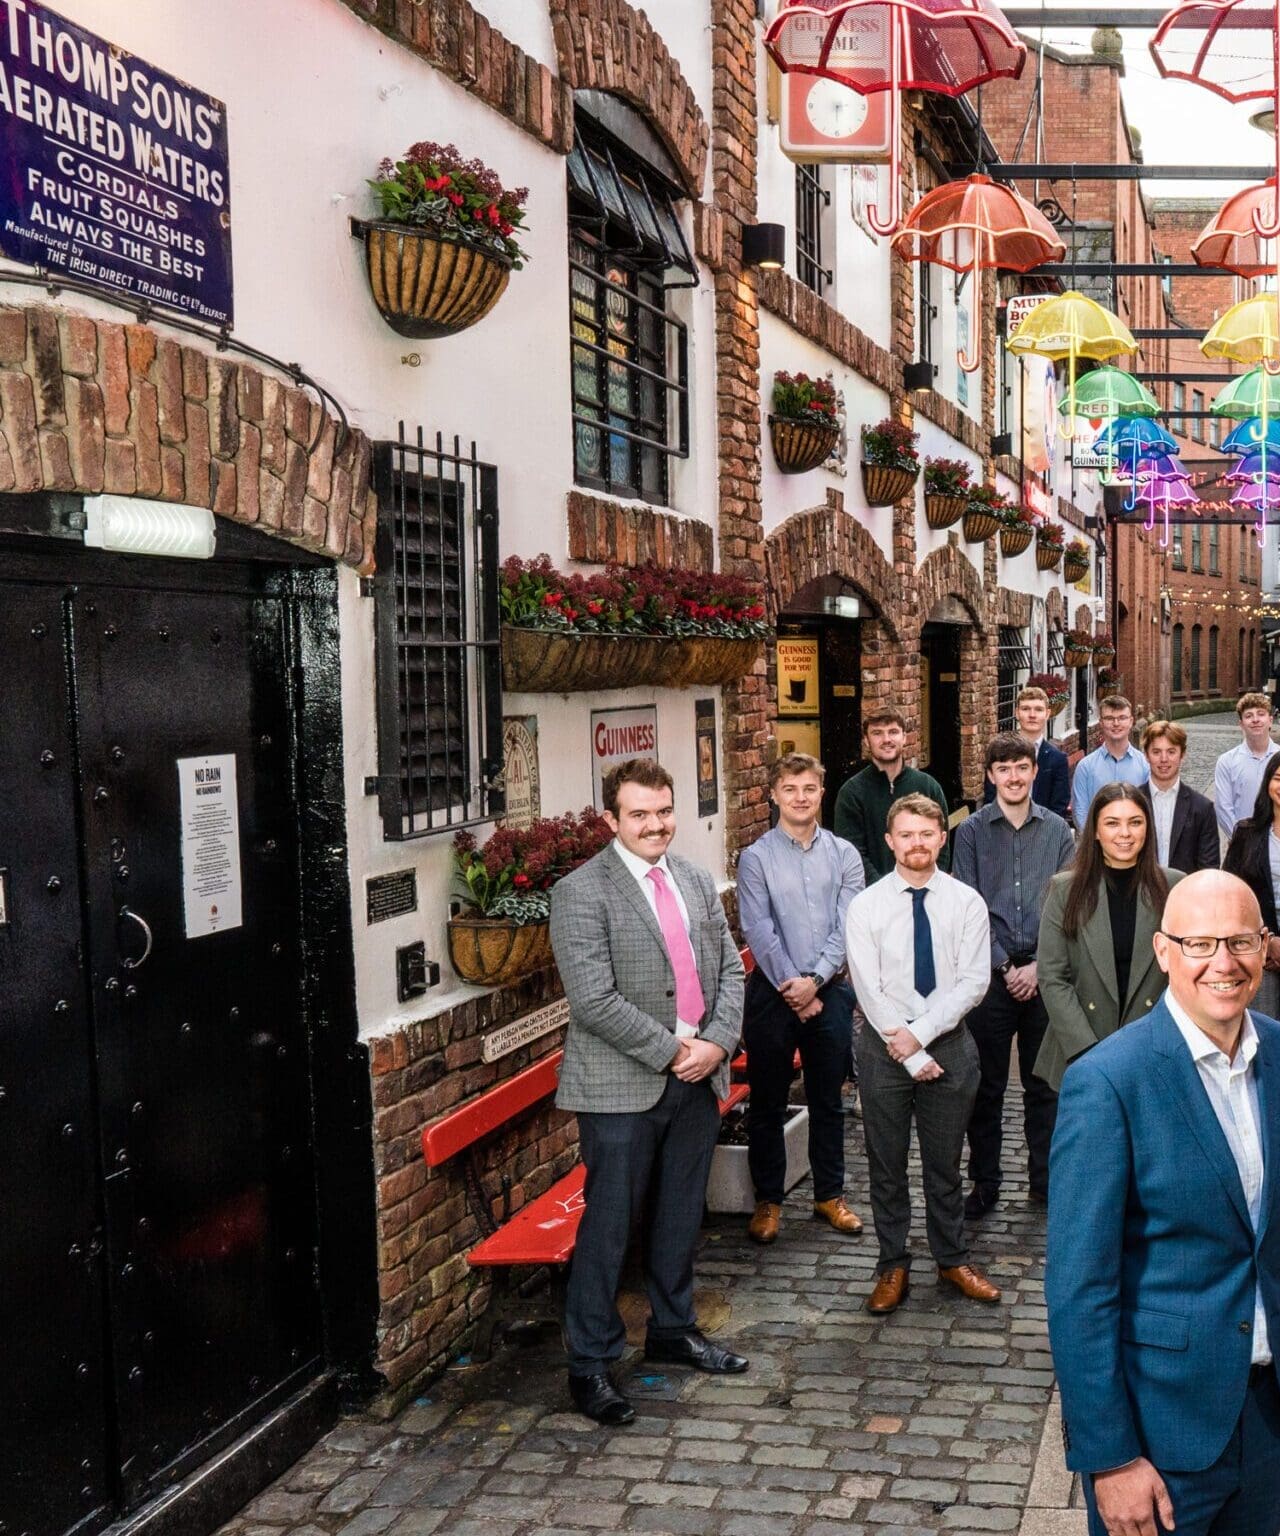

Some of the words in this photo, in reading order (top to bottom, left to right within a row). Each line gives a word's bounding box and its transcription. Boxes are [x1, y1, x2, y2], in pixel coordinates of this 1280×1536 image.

[816, 36, 860, 51] TME
[0, 60, 125, 162] AERATED
[130, 122, 224, 207] WATERS
[57, 151, 178, 220] CORDIALS
[28, 168, 93, 213] FRUIT
[100, 199, 206, 257] SQUASHES
[5, 219, 69, 251] Manufactured
[72, 246, 83, 257] by
[30, 201, 113, 250] ALWAYS
[119, 237, 153, 266] THE
[159, 251, 204, 282] BEST
[47, 248, 66, 267] THE
[69, 255, 97, 276] IRISH
[99, 267, 134, 289] DIRECT
[137, 279, 179, 304] TRADING
[1082, 404, 1109, 413] RED
[1074, 457, 1117, 466] GUINNESS
[779, 645, 816, 655] GUINNESS
[595, 722, 655, 757] GUINNESS
[195, 769, 205, 783] NO
[205, 767, 221, 781] RAIN
[508, 798, 530, 810] DUBLIN
